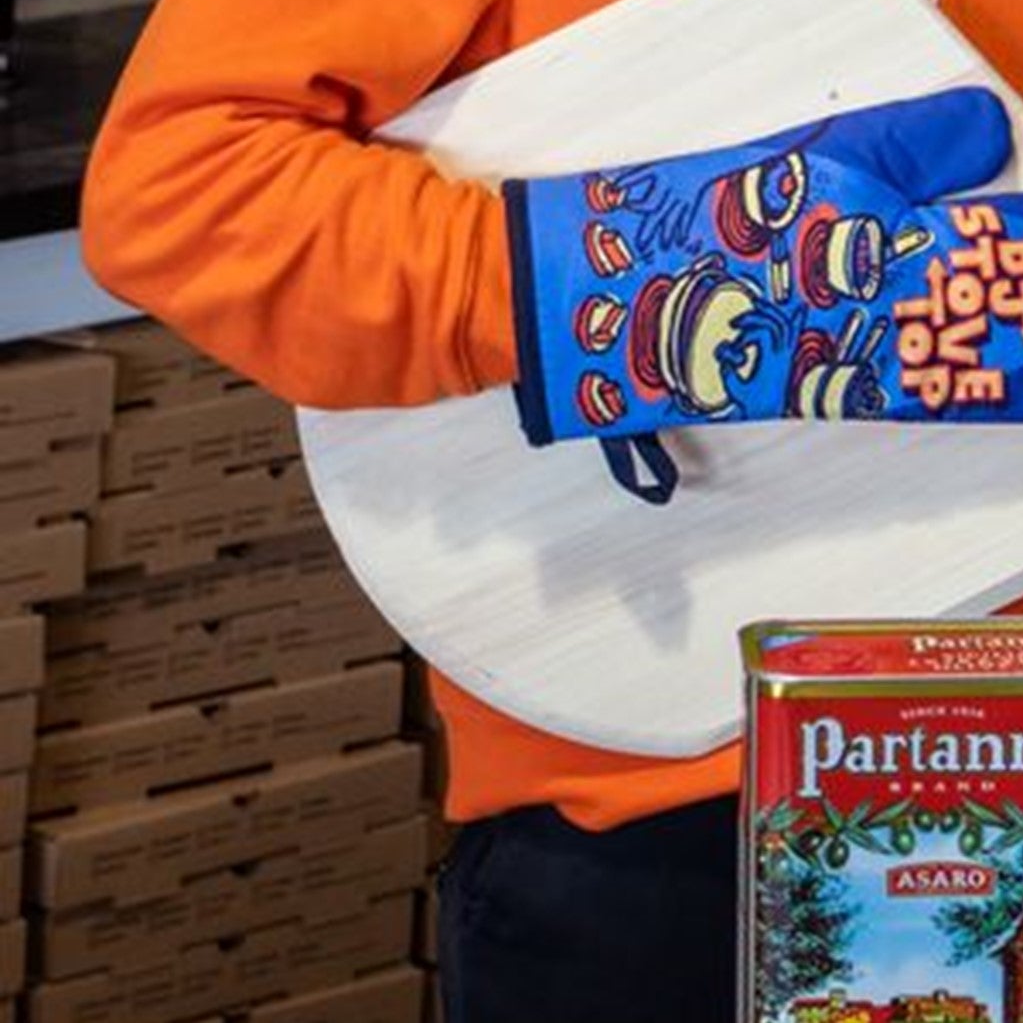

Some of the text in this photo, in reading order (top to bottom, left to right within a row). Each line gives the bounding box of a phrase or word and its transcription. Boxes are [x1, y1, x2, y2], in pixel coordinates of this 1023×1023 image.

[893, 256, 951, 410] TOP
[937, 204, 1004, 402] STOVE
[896, 869, 987, 890] ASARO
